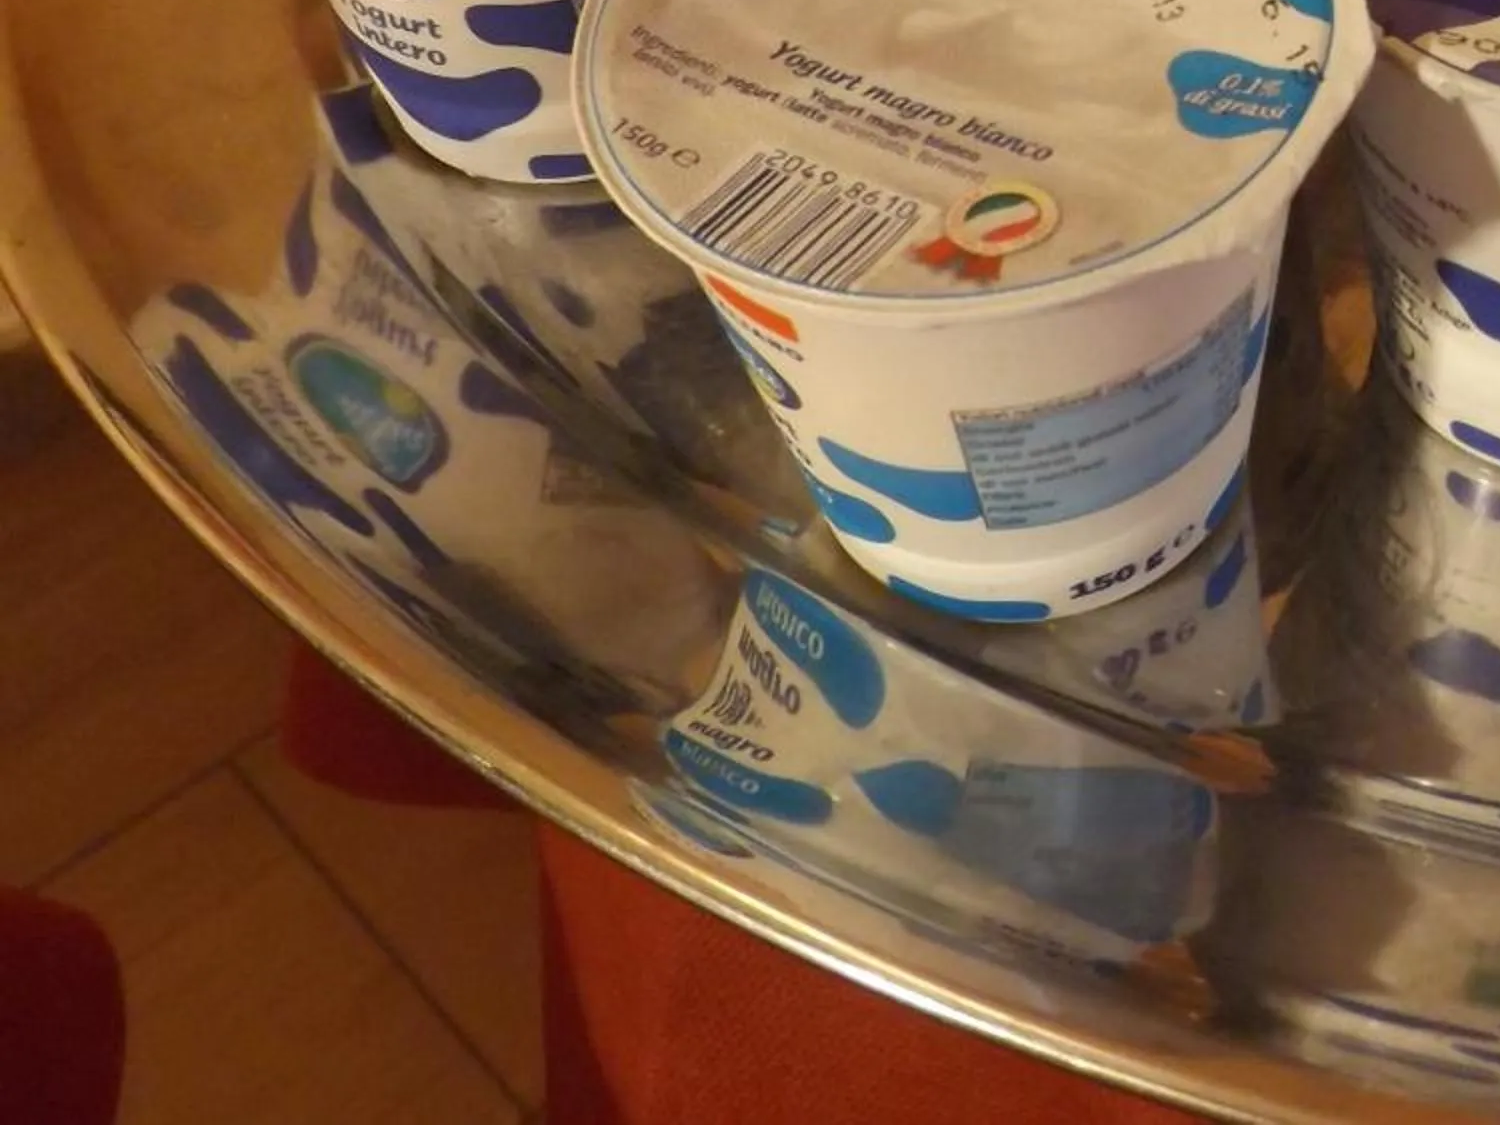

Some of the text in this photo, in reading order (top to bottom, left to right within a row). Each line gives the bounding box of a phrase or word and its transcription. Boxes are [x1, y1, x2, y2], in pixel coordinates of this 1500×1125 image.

[355, 15, 448, 68] intero
[721, 75, 781, 103] yogurt
[769, 41, 1054, 161] Yogurt magro bianco
[811, 88, 865, 118] Yogurt
[865, 114, 920, 140] magro
[1183, 89, 1292, 120] di grassi
[611, 116, 668, 164] 150g
[765, 149, 919, 228] 2049 8610
[1068, 563, 1137, 600] 150
